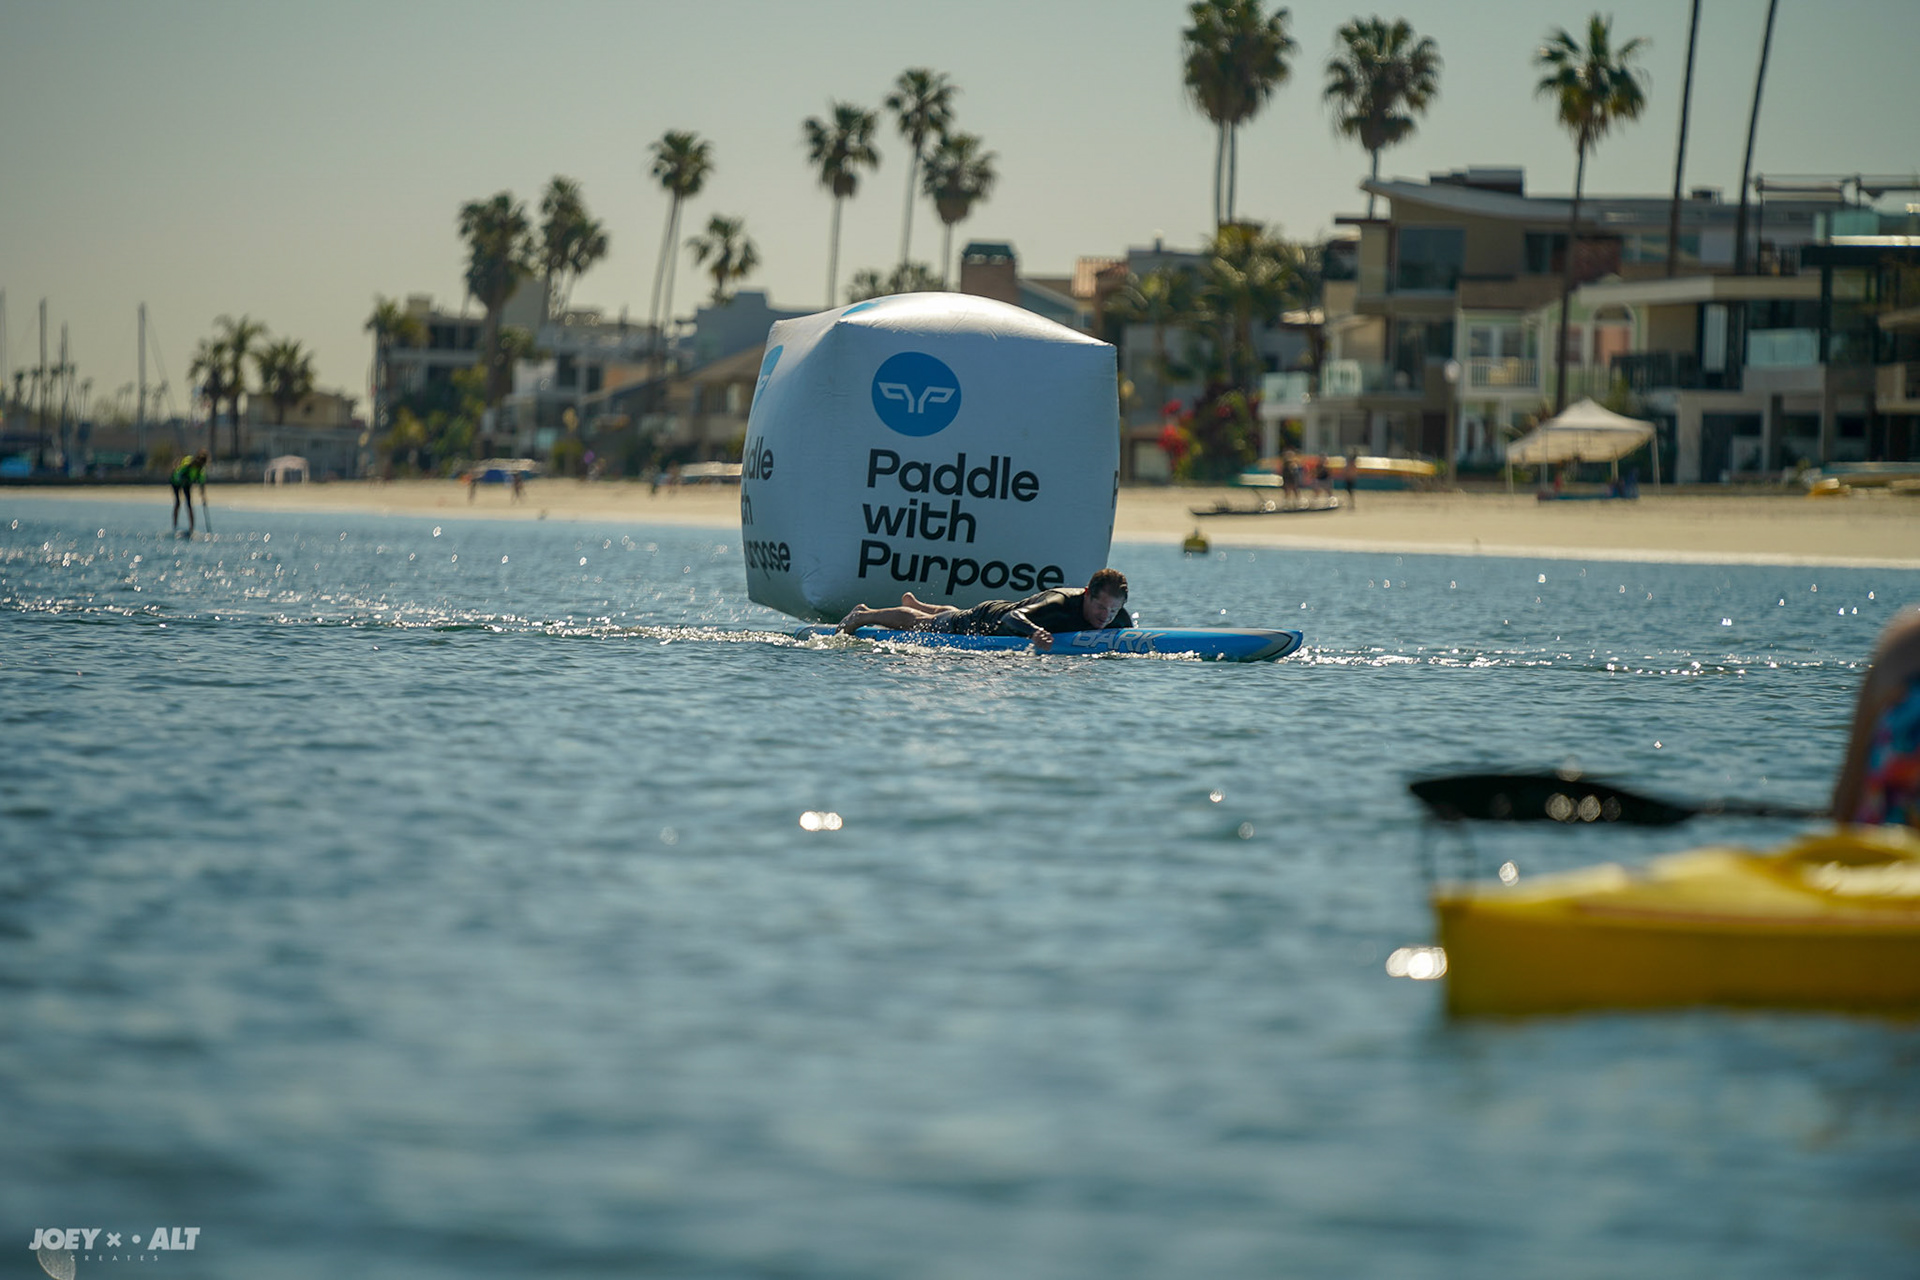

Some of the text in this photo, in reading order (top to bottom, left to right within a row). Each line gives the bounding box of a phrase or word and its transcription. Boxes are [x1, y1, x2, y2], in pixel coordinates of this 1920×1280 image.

[867, 448, 1040, 502] Paddle
[862, 498, 976, 543] with
[858, 539, 1065, 596] Purpose
